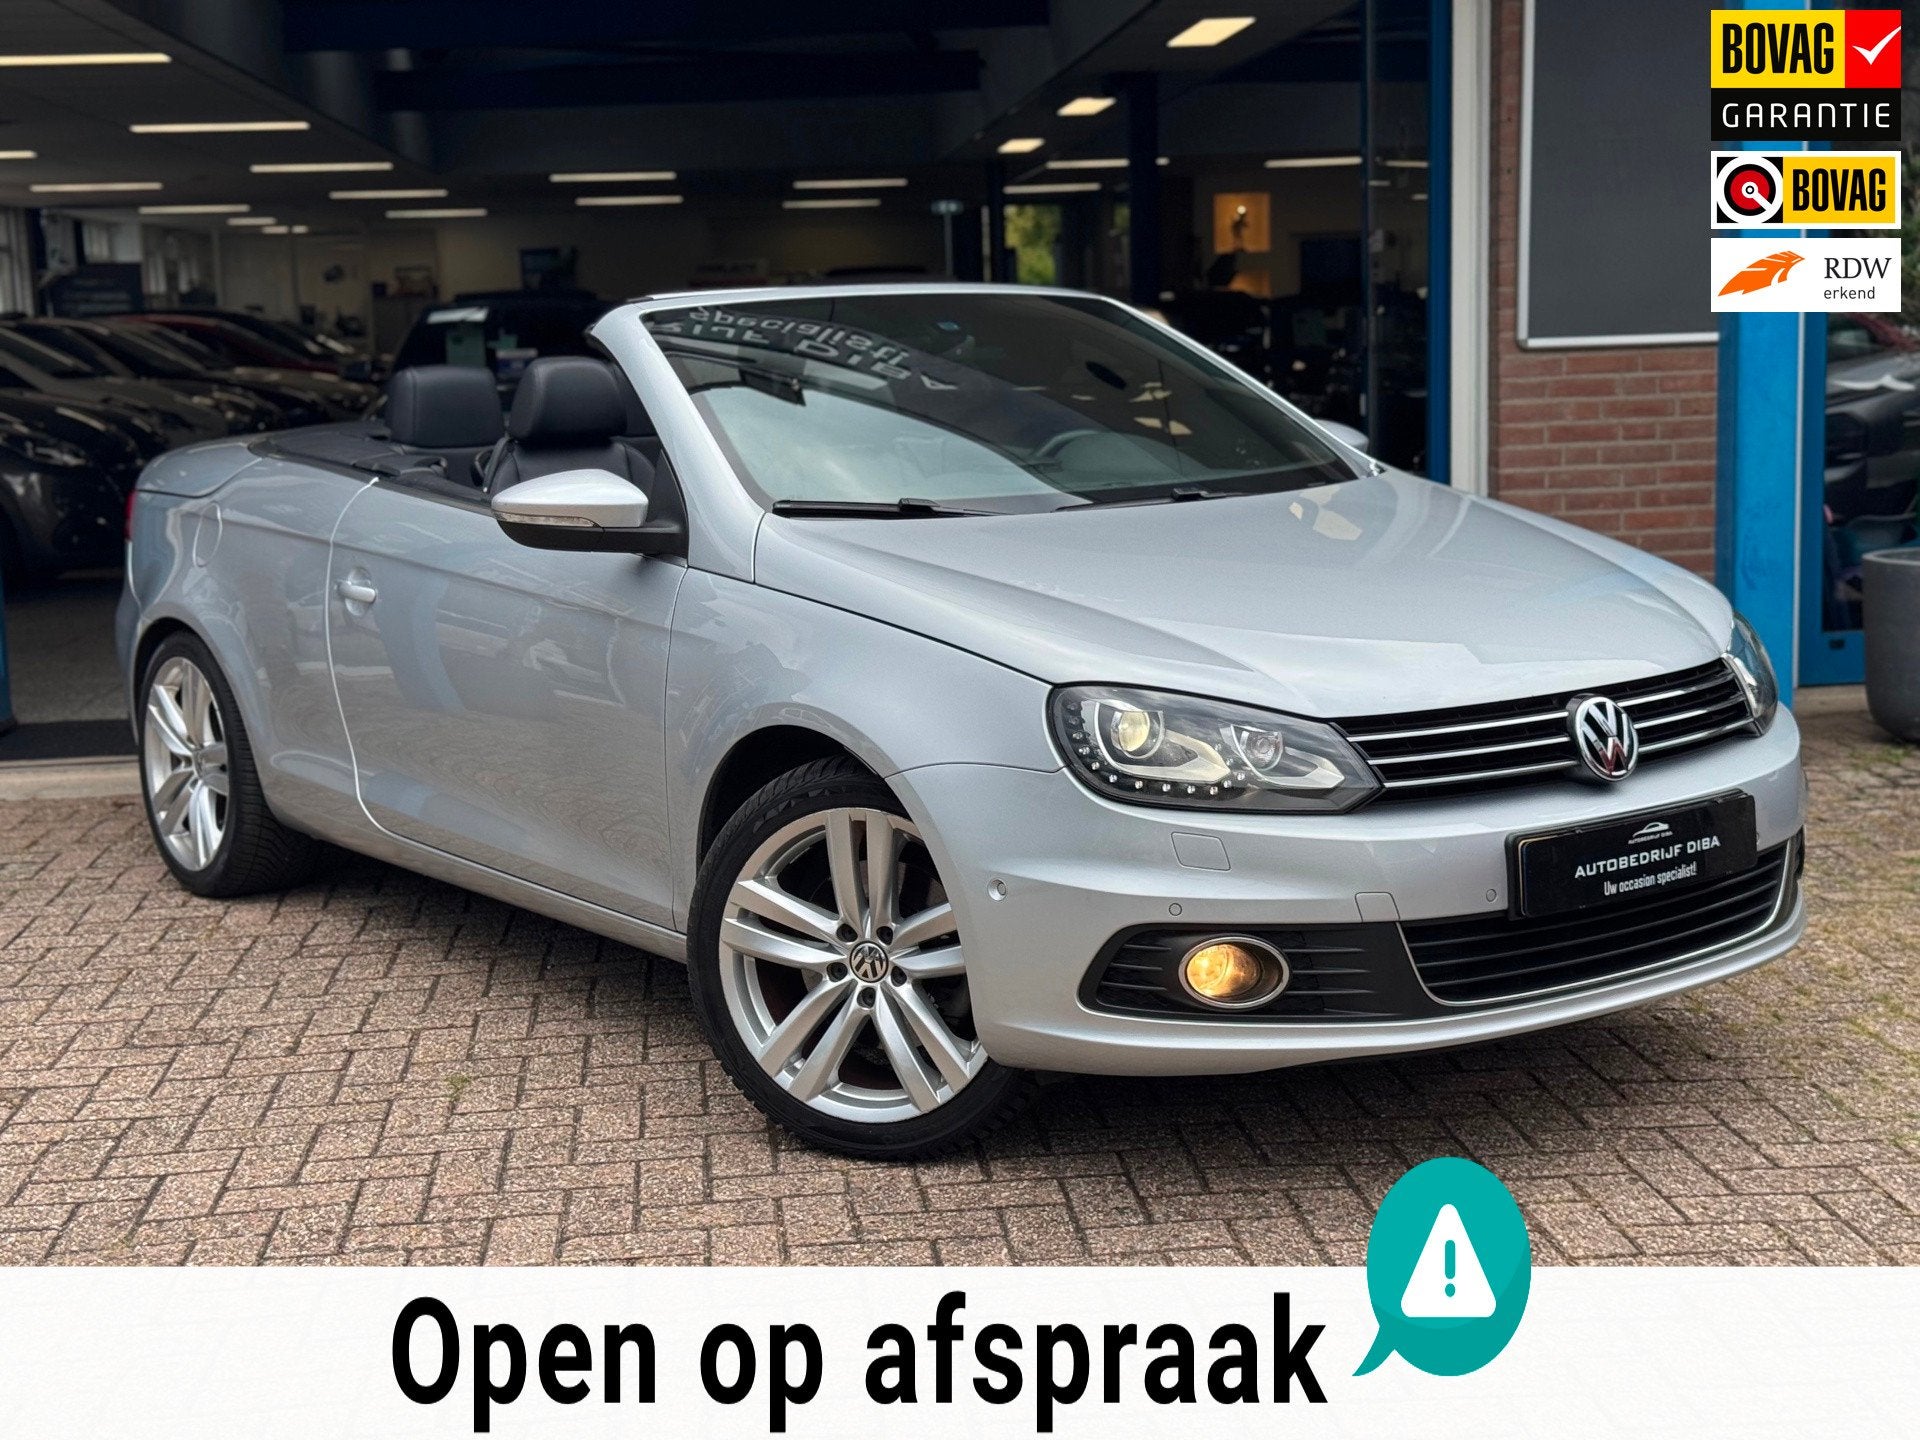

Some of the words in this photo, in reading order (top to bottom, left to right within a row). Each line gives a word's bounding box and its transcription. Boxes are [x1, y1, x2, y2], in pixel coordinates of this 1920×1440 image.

[1574, 843, 1683, 879] AUTOBEDRIJF
[1686, 834, 1722, 855] DIBA
[1603, 880, 1617, 897] Uw
[1619, 873, 1656, 893] occasion
[1657, 860, 1698, 888] specialist!
